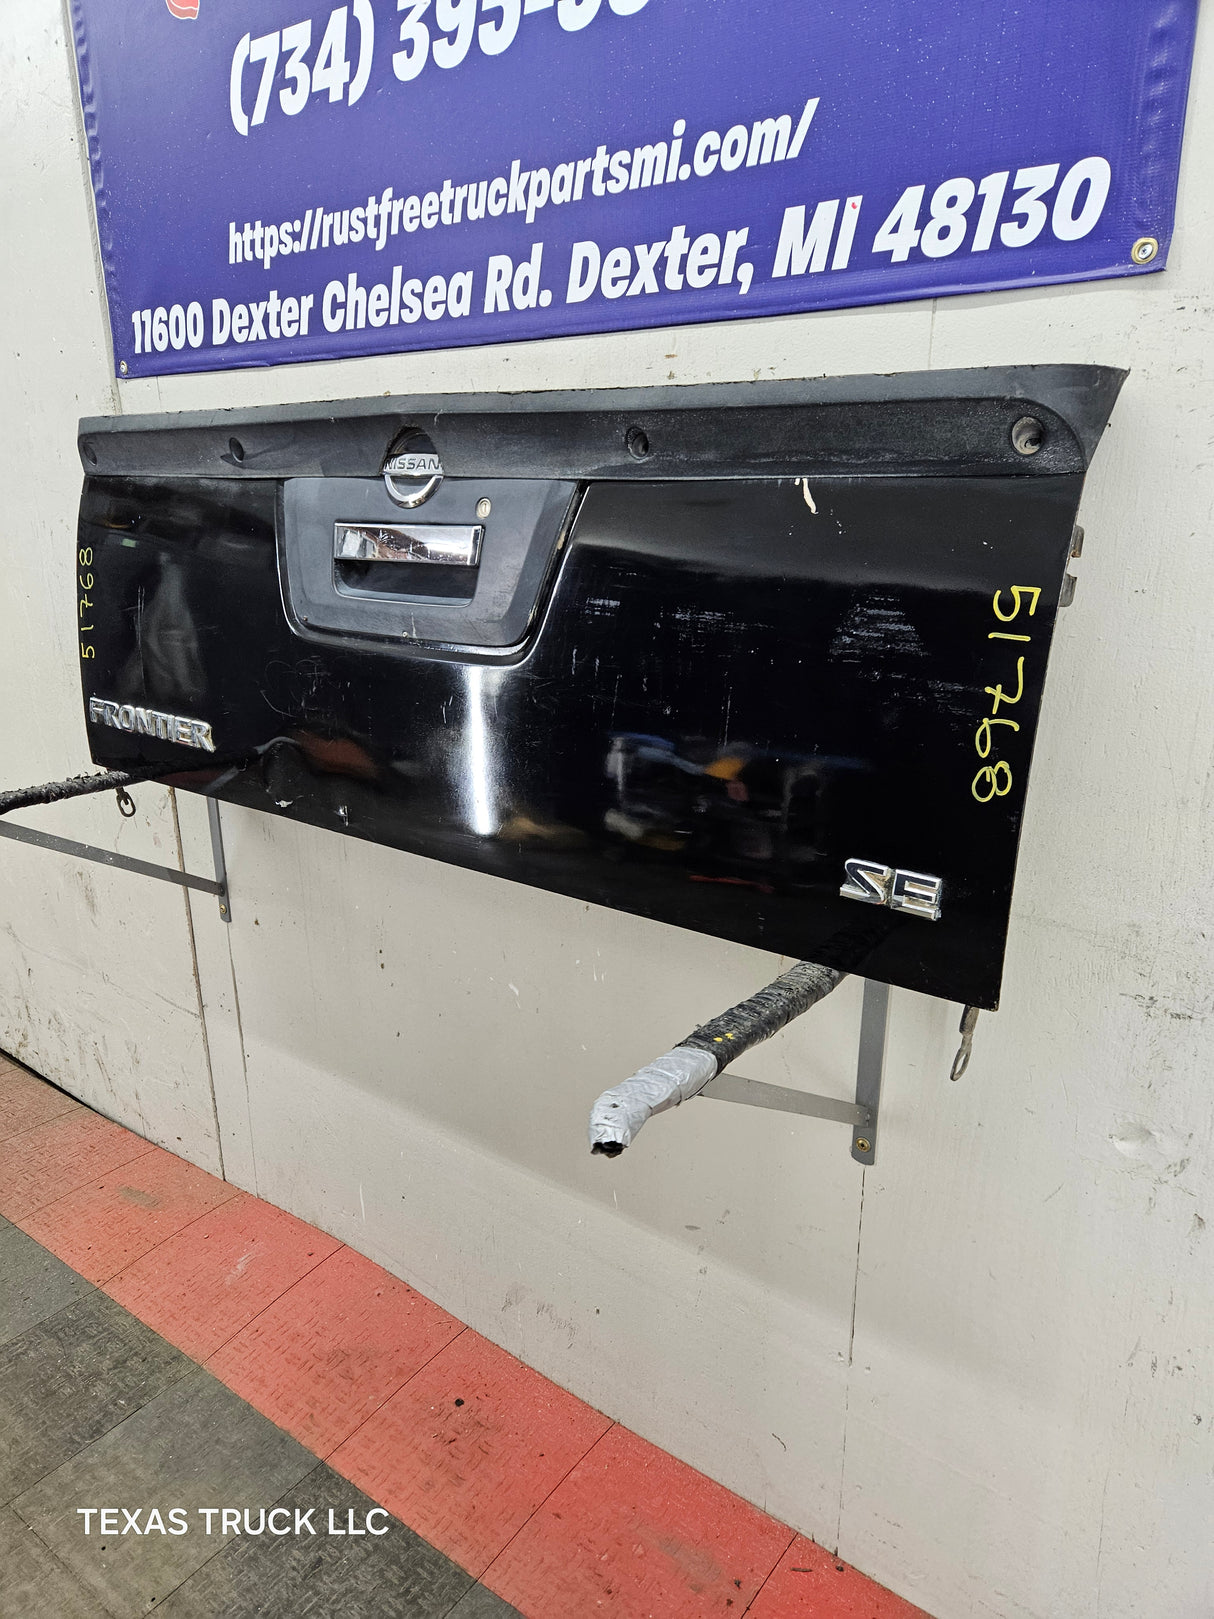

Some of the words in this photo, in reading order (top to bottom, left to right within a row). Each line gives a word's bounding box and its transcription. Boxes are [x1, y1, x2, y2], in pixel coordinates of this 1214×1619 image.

[229, 0, 375, 136] (734)
[392, 0, 649, 82] 395-
[228, 97, 821, 268] https://rustfreetruckpartsmi.com/
[131, 302, 205, 354] 11600
[212, 290, 314, 346] Dexter
[322, 265, 474, 332] Chelsea
[483, 242, 553, 314] Rd.
[565, 225, 754, 304] Dexter,
[772, 195, 864, 279] MI
[872, 157, 1112, 263] 48130
[384, 457, 442, 471] NISSAN
[79, 547, 95, 659] 51768
[89, 697, 216, 753] FRONTIER
[972, 585, 1042, 803] 51768
[839, 858, 942, 921] SE
